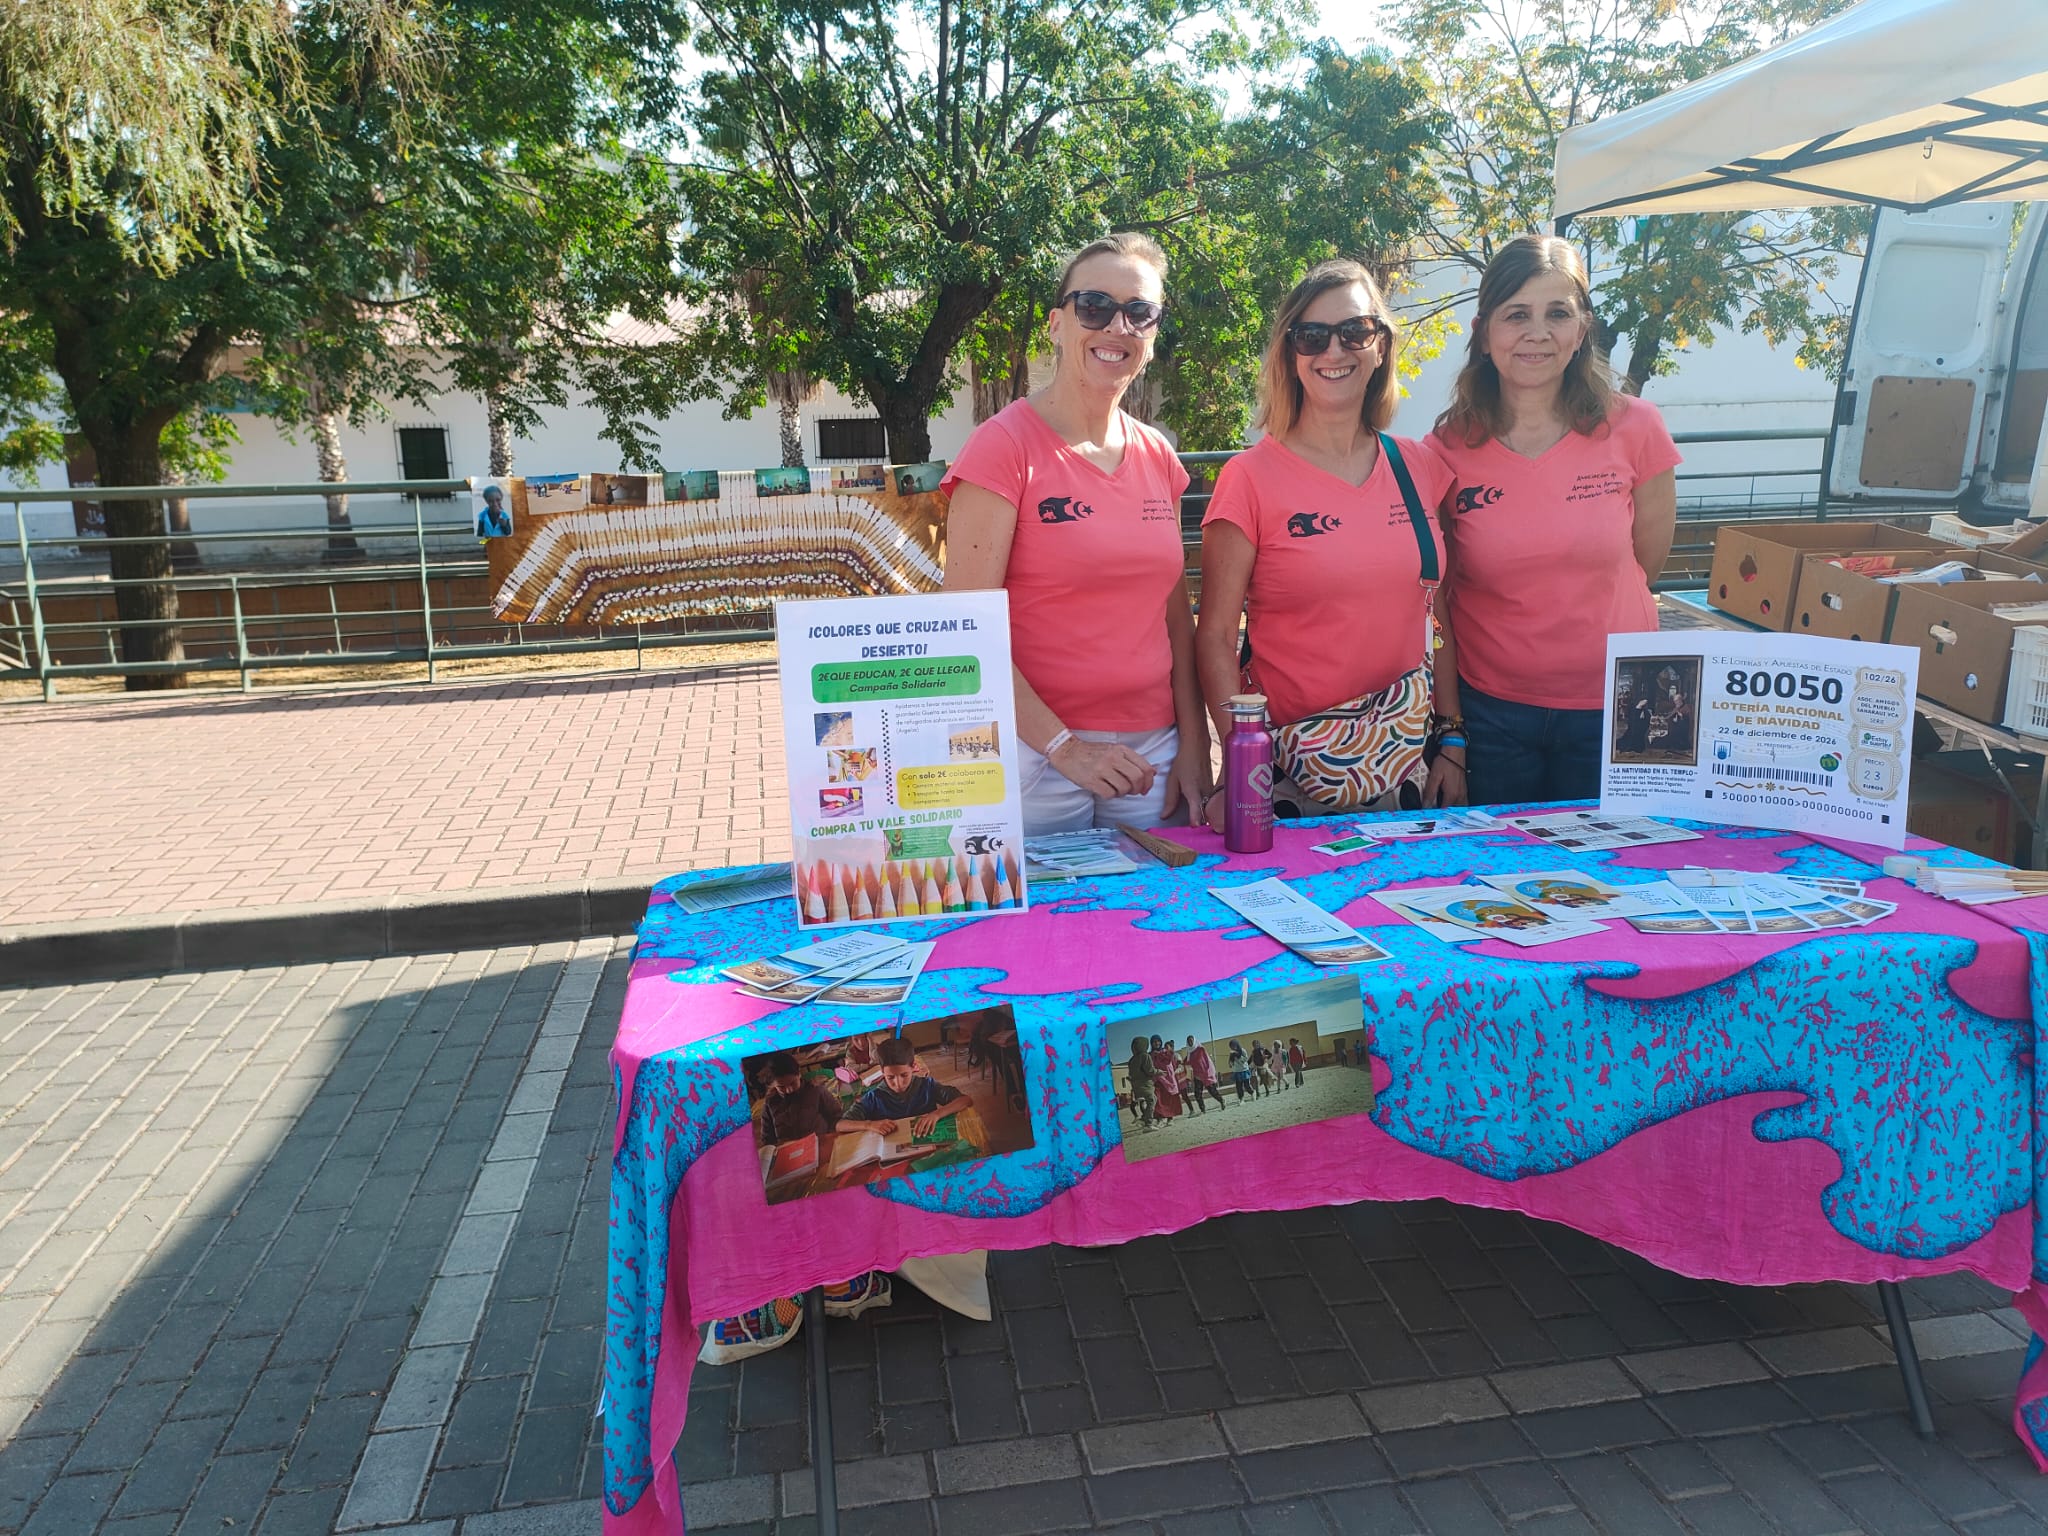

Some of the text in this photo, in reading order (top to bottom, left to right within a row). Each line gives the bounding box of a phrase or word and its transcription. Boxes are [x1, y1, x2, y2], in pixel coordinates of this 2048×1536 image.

[876, 622, 901, 634] QUE
[906, 620, 958, 632] CRUZAN
[962, 618, 978, 630] EL
[854, 670, 896, 680] EDUCAN,
[900, 668, 912, 677] 2€
[914, 666, 934, 676] QUE
[936, 665, 975, 675] LLEGAN
[1865, 672, 1896, 684] 102/26
[850, 679, 946, 694] Campaña Solidaria
[1726, 670, 1843, 704] 80050
[1712, 700, 1845, 721] LOTERÍA NACIONAL
[1736, 716, 1820, 730] DE NAVIDAD
[1732, 728, 1744, 736] de
[1748, 730, 1797, 740] diciembre
[1800, 733, 1812, 742] de
[1816, 736, 1836, 746] 2026
[919, 772, 936, 780] solo
[949, 770, 984, 778] colaboras
[1722, 792, 1873, 821] 5000010000>0000000000
[811, 809, 963, 838] COMPRA TU VALE SOLIDARIO
